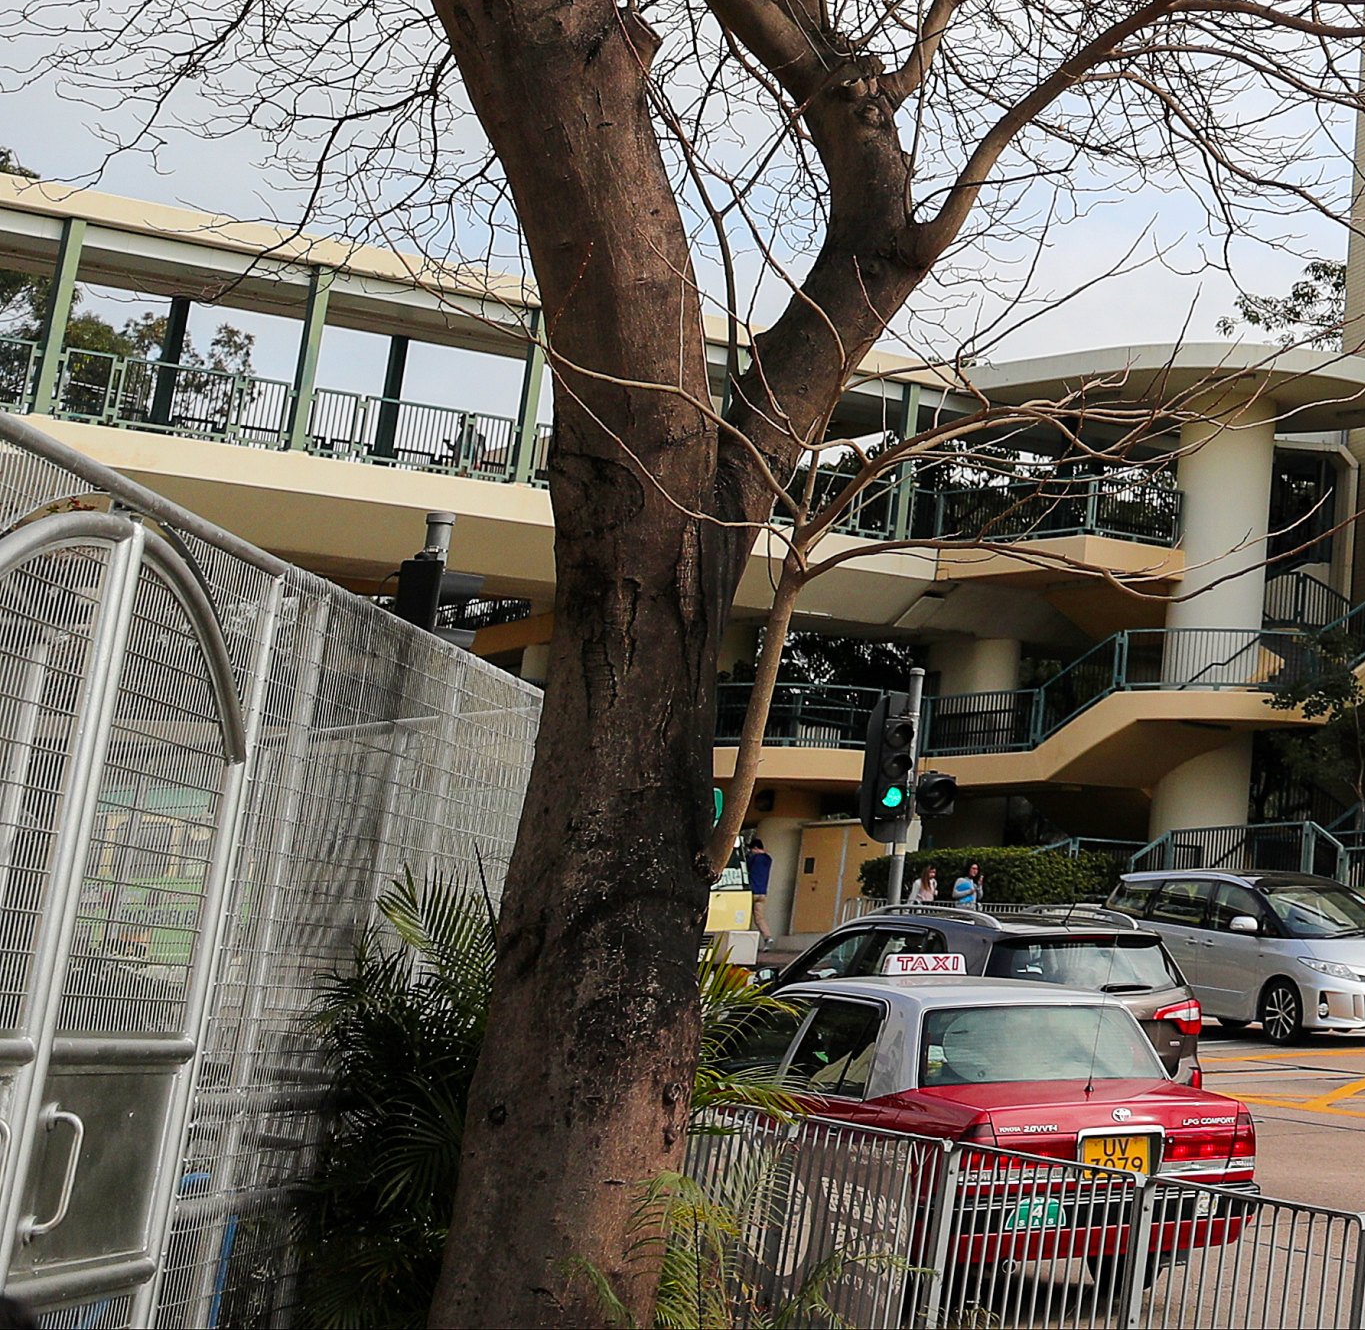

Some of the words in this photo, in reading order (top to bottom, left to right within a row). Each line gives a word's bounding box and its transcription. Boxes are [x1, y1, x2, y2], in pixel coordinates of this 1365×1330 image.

[896, 955, 960, 972] TAXI
[1182, 1118, 1200, 1126] LPG
[1200, 1116, 1236, 1125] COMFORT
[1103, 1138, 1130, 1157] UV
[1031, 1204, 1044, 1219] 4
